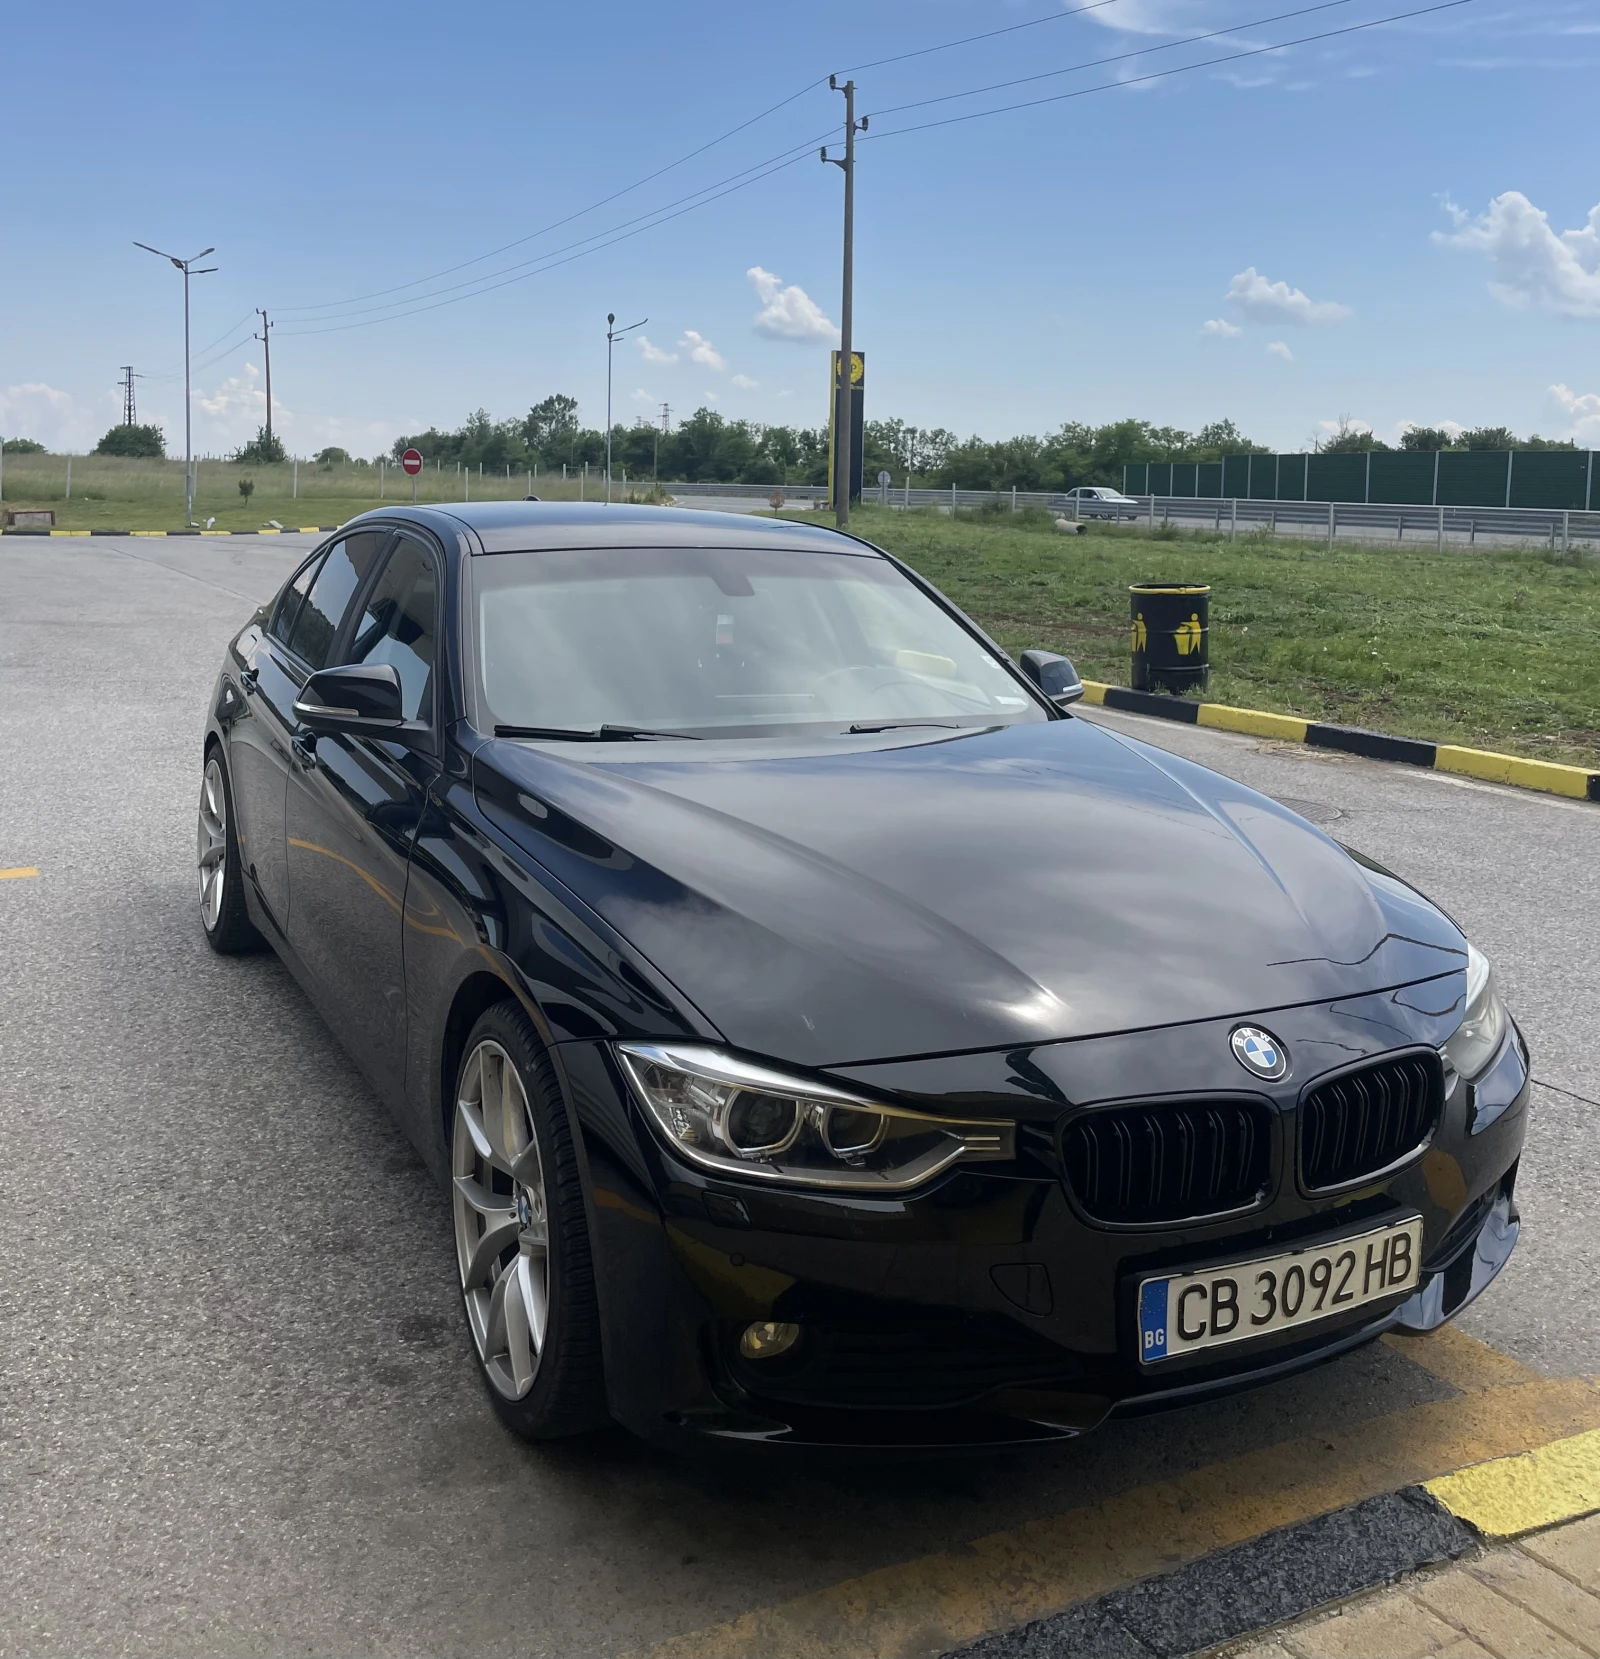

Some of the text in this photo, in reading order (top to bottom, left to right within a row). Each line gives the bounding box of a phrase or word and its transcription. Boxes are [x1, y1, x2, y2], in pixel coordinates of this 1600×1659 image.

[1234, 1028, 1271, 1047] BMW
[1177, 1231, 1412, 1341] CB 3092 HB
[1144, 1328, 1165, 1349] BG
